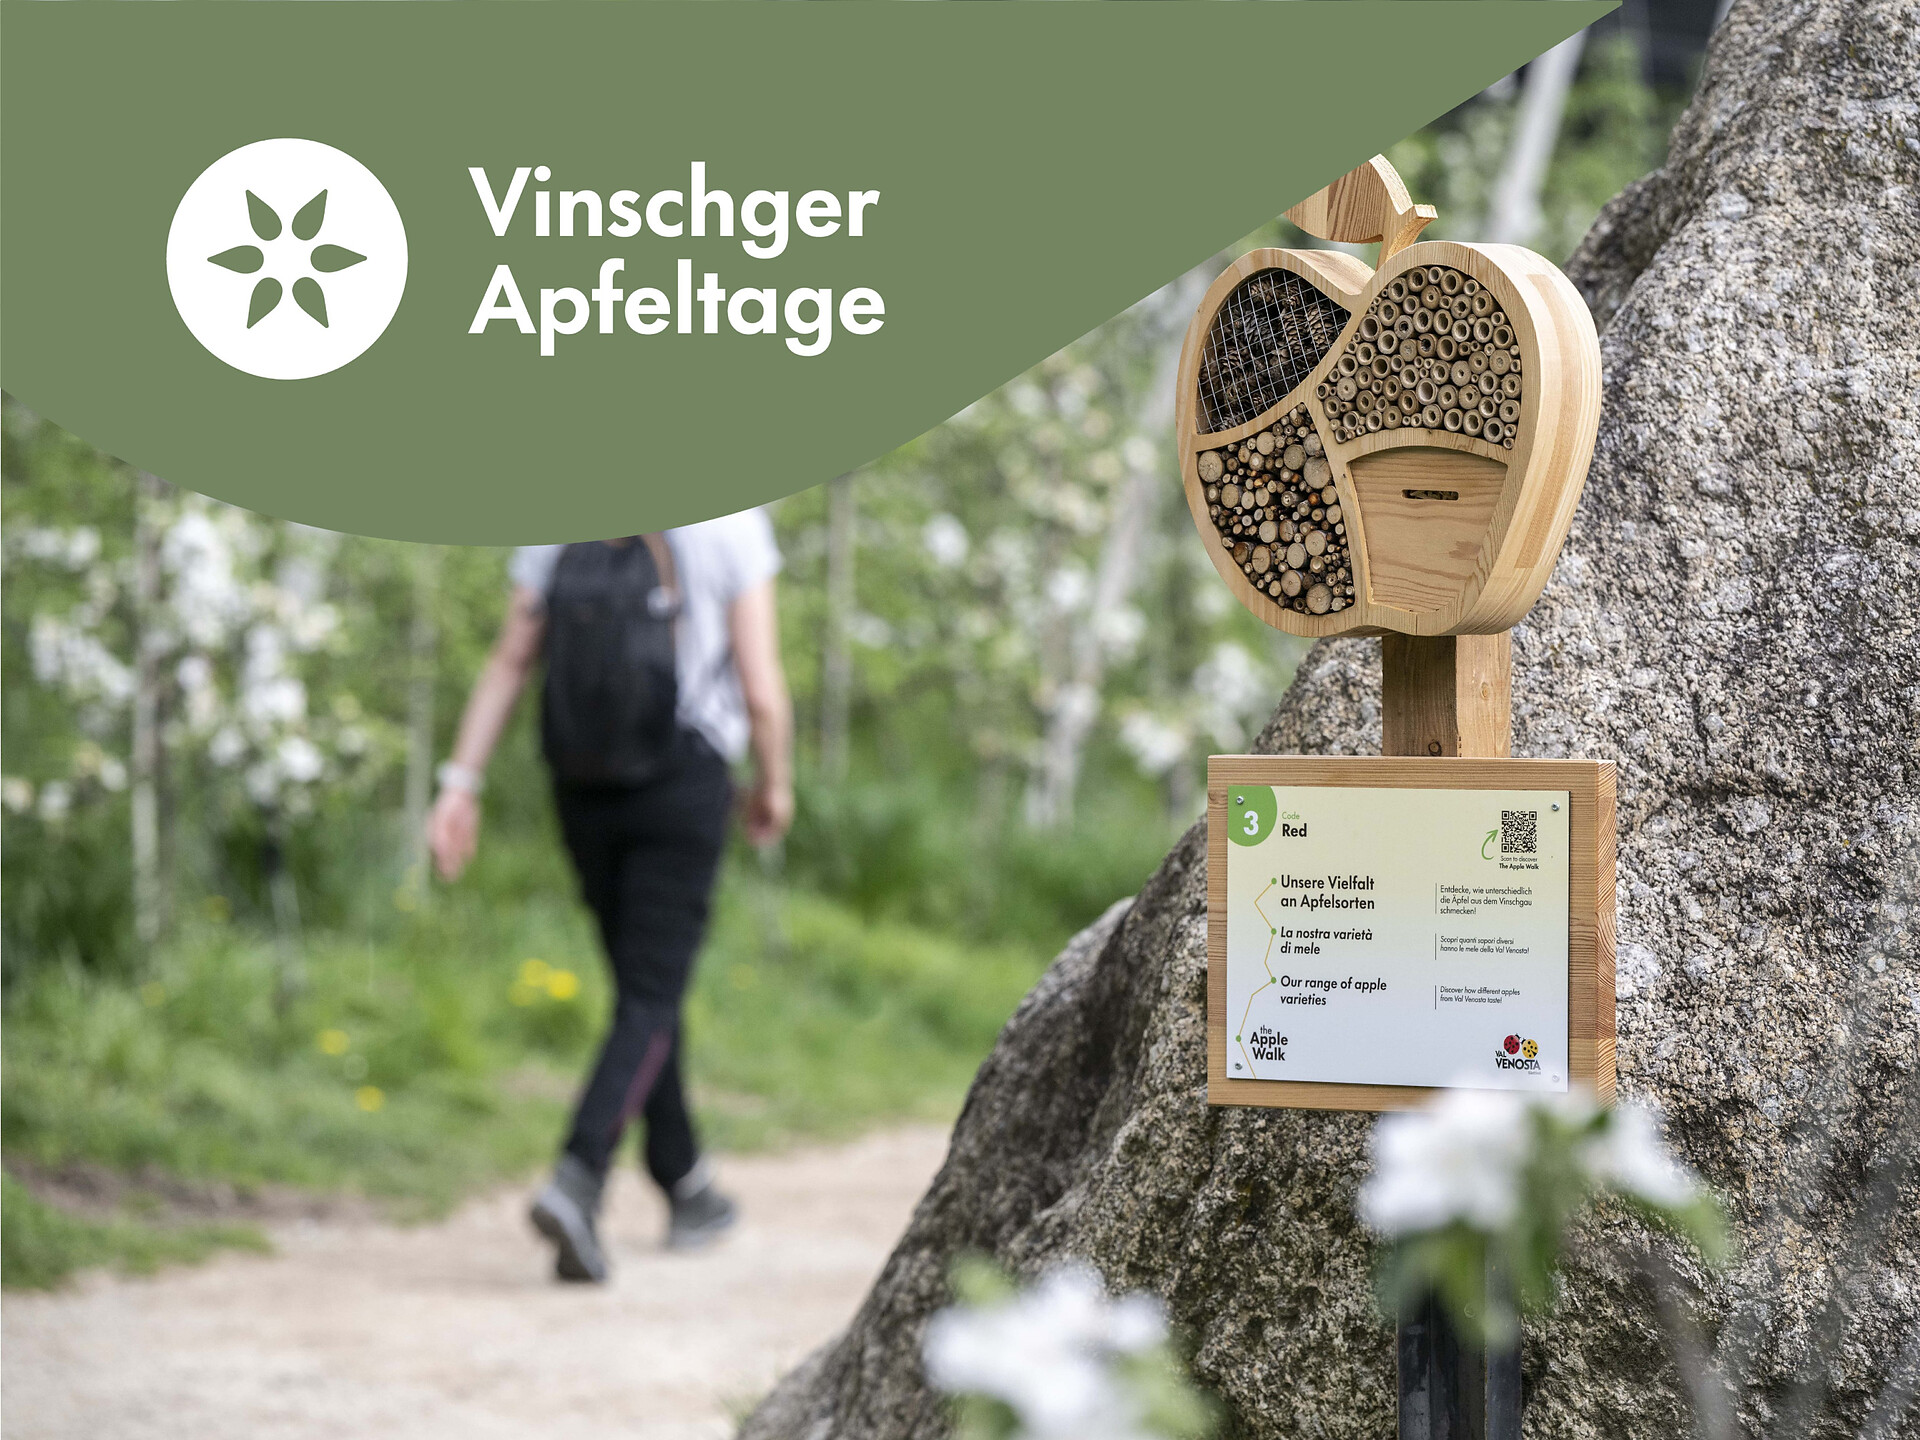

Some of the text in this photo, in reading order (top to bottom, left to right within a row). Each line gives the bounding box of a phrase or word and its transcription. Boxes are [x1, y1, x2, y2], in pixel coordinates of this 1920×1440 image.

[1282, 812, 1300, 820] Code
[1243, 811, 1259, 835] 3
[1282, 823, 1307, 837] Red
[1281, 875, 1374, 890] Unsere Vielfalt
[1440, 885, 1532, 895] Entdecke, wie unterschiedlich
[1281, 894, 1375, 911] an Apfelsorten
[1440, 896, 1450, 904] die
[1452, 894, 1469, 905] Äpfel
[1483, 897, 1497, 905] dem
[1499, 898, 1532, 907] Vinschgau
[1281, 927, 1372, 940] La nostra varietà
[1440, 936, 1458, 944] Scopri
[1281, 942, 1320, 954] di mele
[1281, 975, 1387, 993] Our range of apple
[1501, 988, 1520, 996] apples
[1281, 994, 1326, 1005] varieties
[1260, 1025, 1272, 1034] the
[1250, 1032, 1288, 1048] Apple
[1252, 1047, 1285, 1061] Walk
[1495, 1059, 1541, 1070] VENOSTA
